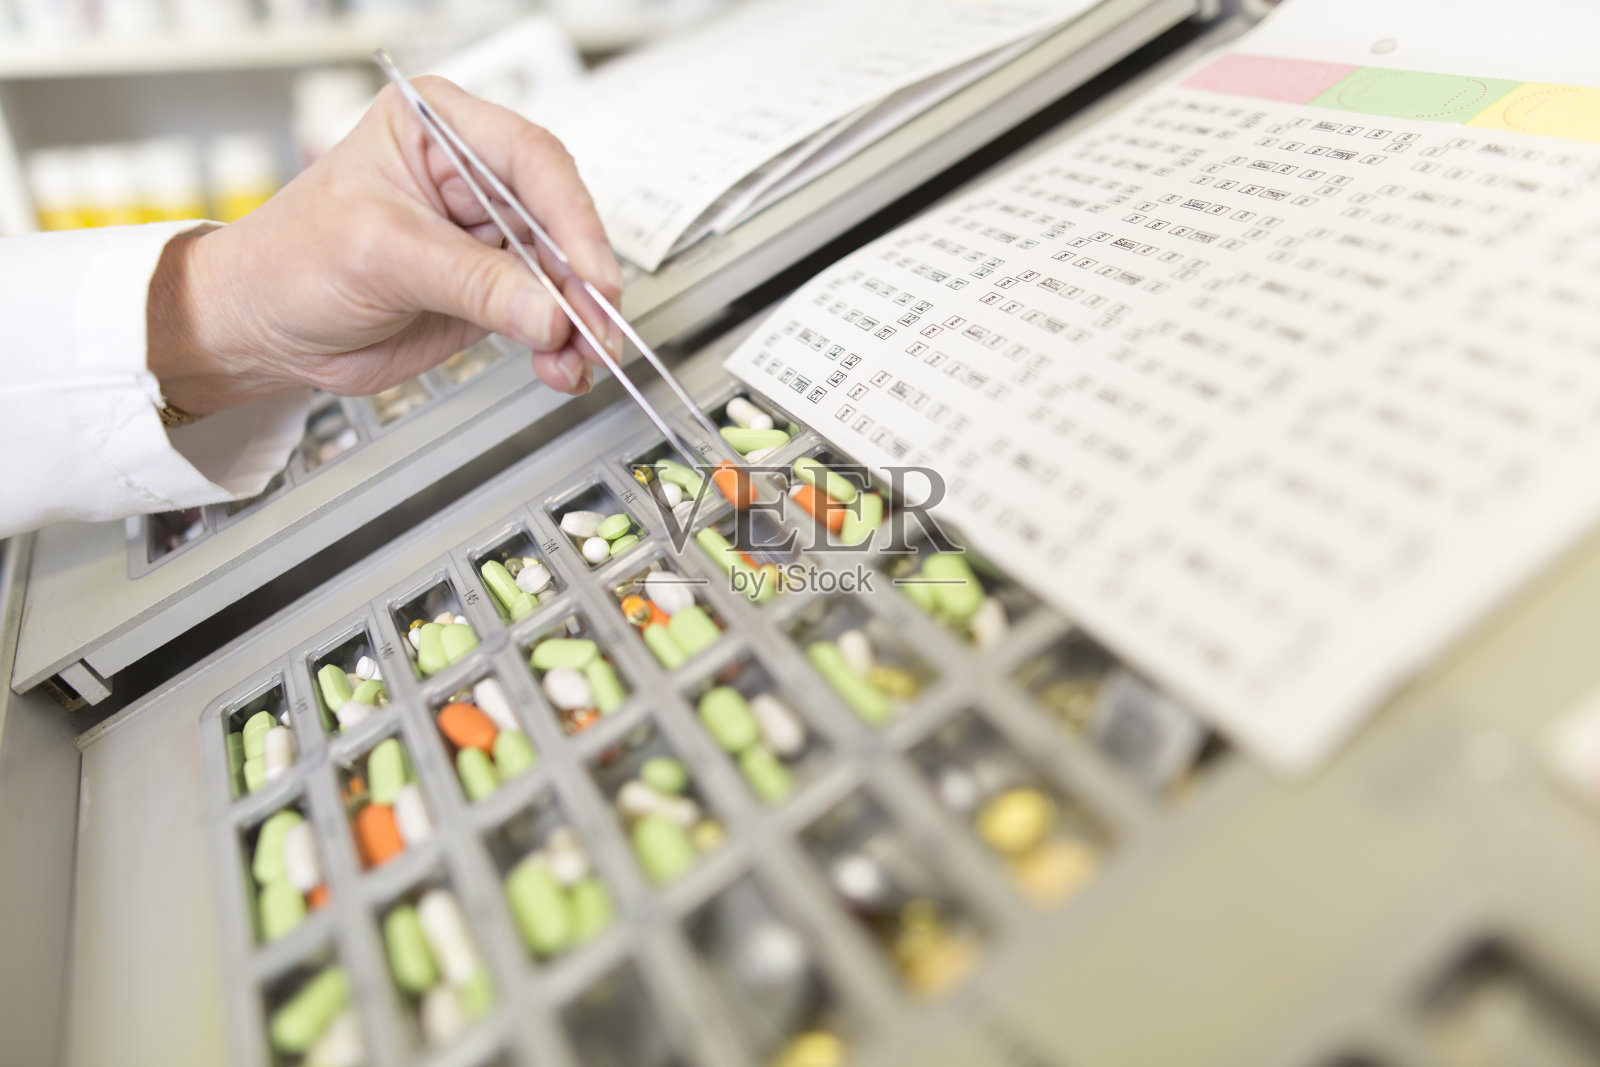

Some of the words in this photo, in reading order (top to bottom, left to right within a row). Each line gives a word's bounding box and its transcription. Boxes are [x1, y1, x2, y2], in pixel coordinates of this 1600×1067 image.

[829, 347, 842, 357] 12
[844, 356, 858, 367] 12
[830, 373, 844, 384] 12
[810, 389, 823, 401] 12
[620, 489, 637, 504] 143
[543, 538, 560, 555] 144
[464, 589, 480, 606] 145
